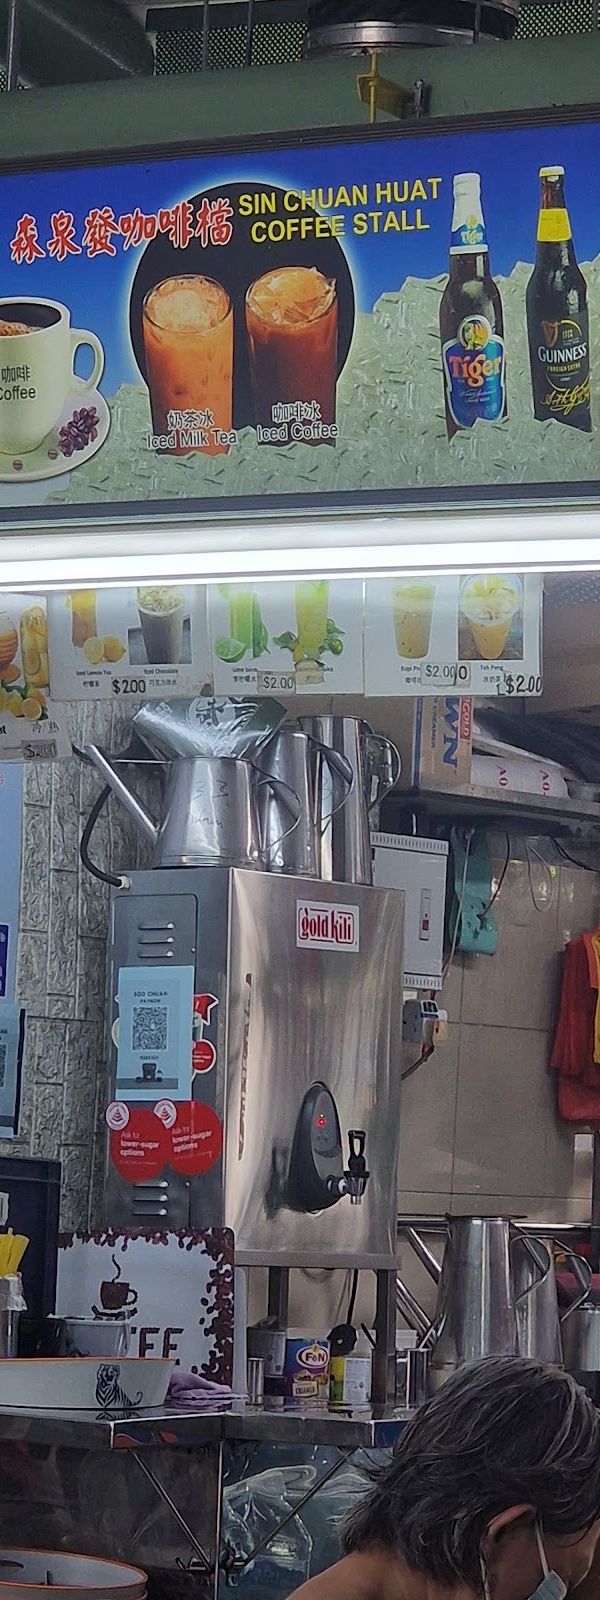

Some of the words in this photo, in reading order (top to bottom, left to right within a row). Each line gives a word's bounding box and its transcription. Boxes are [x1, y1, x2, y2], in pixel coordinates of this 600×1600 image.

[238, 192, 277, 216] SIN
[283, 184, 368, 212] CHUAN
[376, 177, 443, 204] HUAT
[10, 198, 234, 264] 森泉發咖啡檔
[251, 214, 346, 243] COFFEE
[353, 208, 430, 235] STALL
[538, 342, 588, 363] GUINNESS
[1, 364, 31, 383] 咖啡
[449, 354, 502, 387] Tiger
[168, 410, 214, 430] 奶茶冰
[272, 402, 322, 423] 咖啡冰
[148, 432, 176, 449] Iced
[180, 430, 209, 447] Milk
[212, 428, 238, 446] Tea
[258, 423, 288, 441] Iced
[292, 422, 339, 440] Coffee
[425, 664, 456, 678] $2.00
[263, 676, 294, 689] $2.00
[505, 674, 541, 695] $2.00
[301, 907, 329, 940] gold
[331, 910, 352, 943] kili
[120, 1139, 160, 1150] lower-sugar
[172, 1130, 212, 1144] lower-sugar
[120, 1149, 145, 1158] options
[173, 1142, 199, 1153] options
